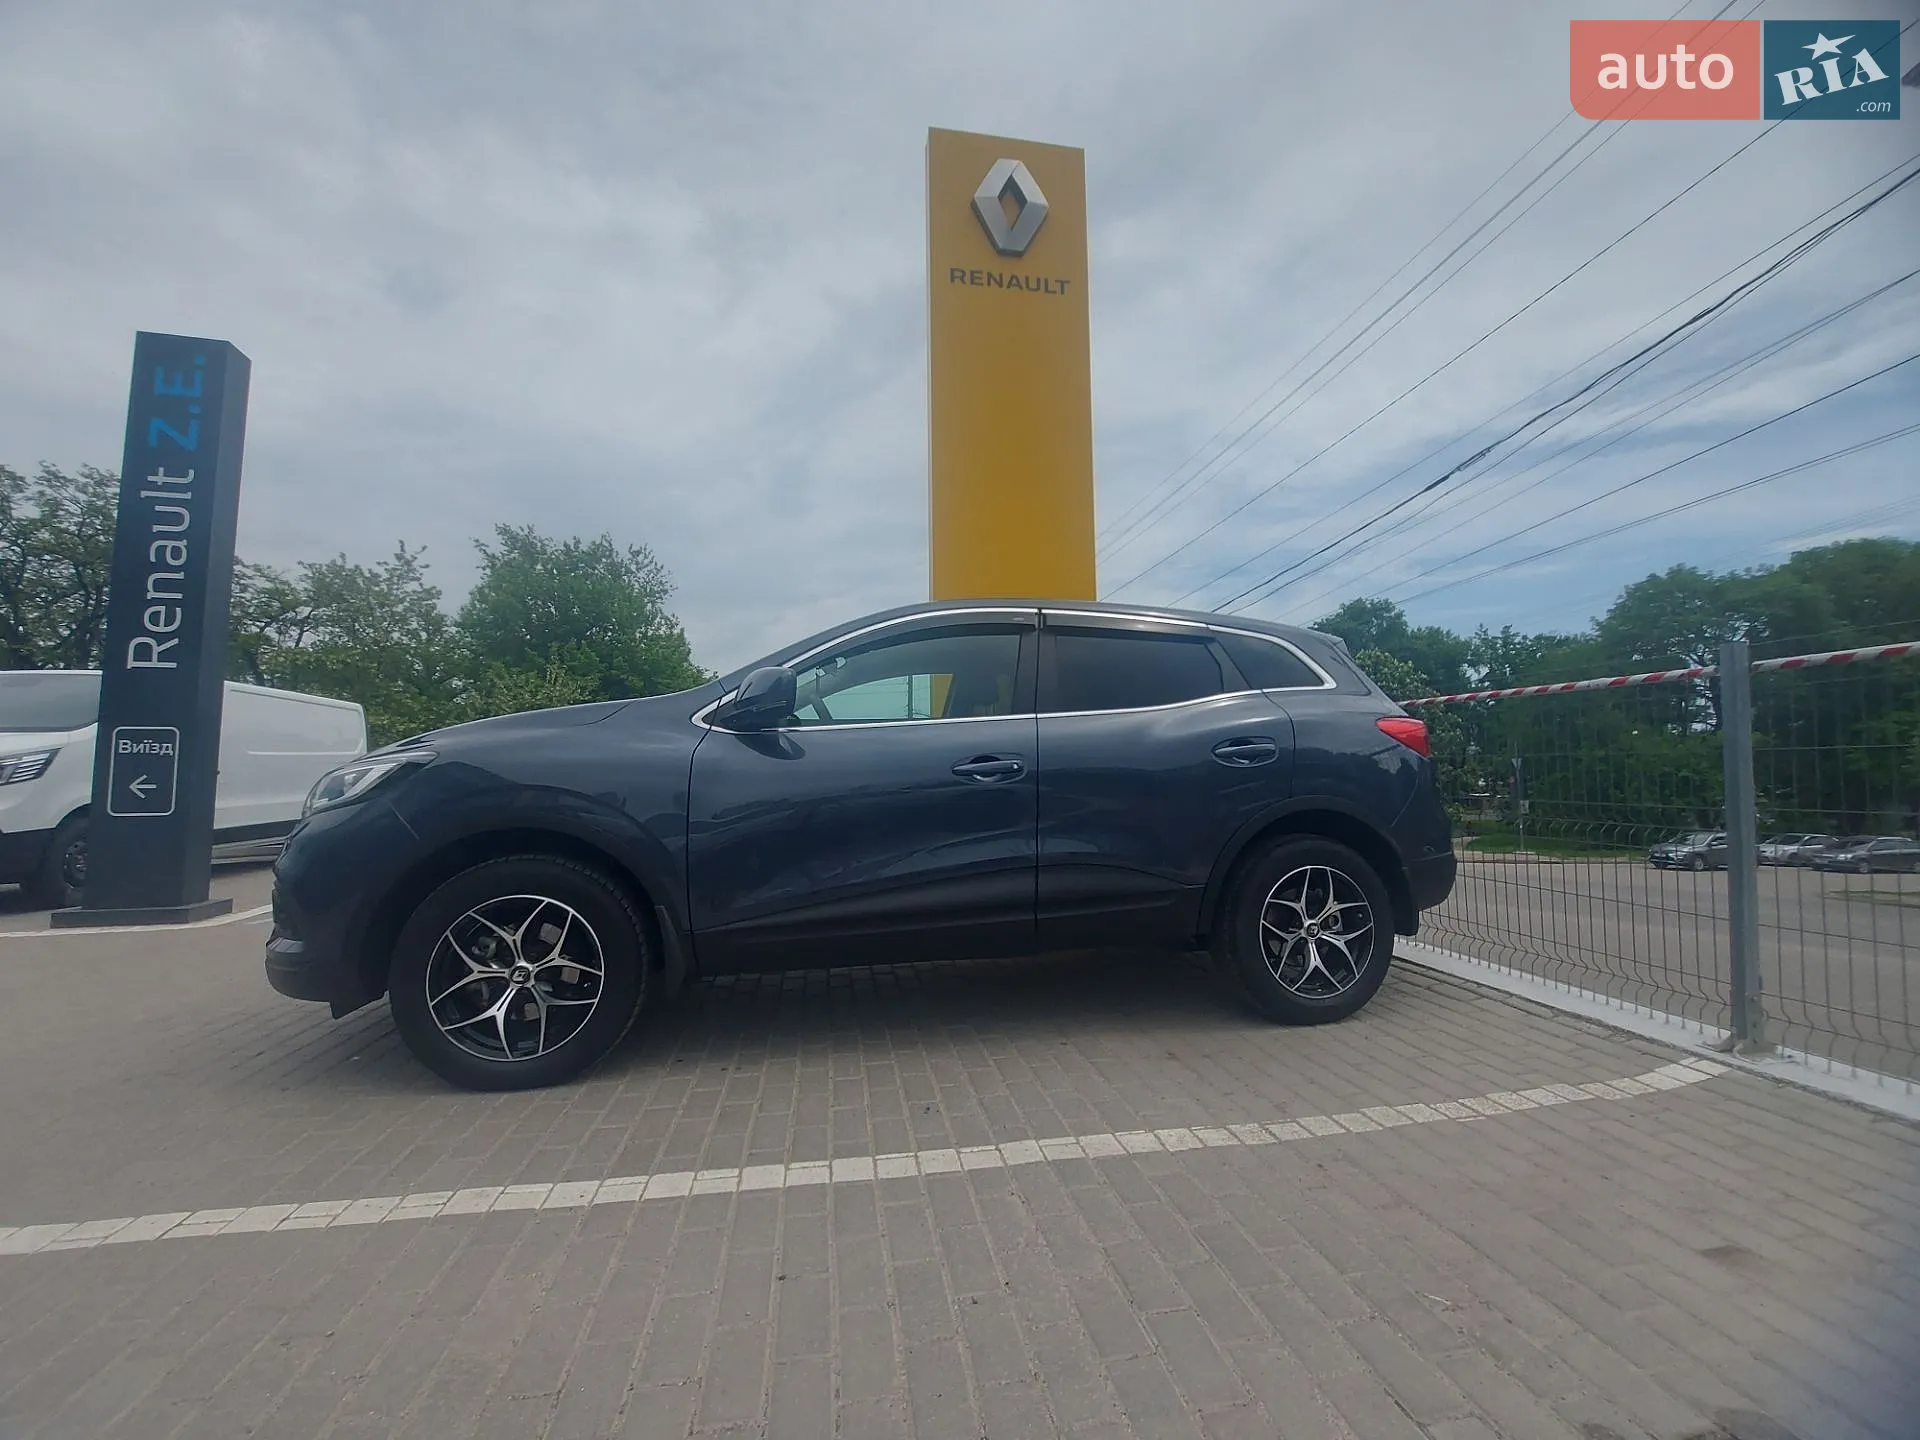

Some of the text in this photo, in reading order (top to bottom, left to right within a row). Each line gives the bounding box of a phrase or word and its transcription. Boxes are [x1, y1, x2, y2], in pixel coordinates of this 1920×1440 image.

[950, 267, 1071, 296] RENAULT
[127, 355, 206, 669] Renault Z.E.
[118, 739, 173, 756] Виїзд
